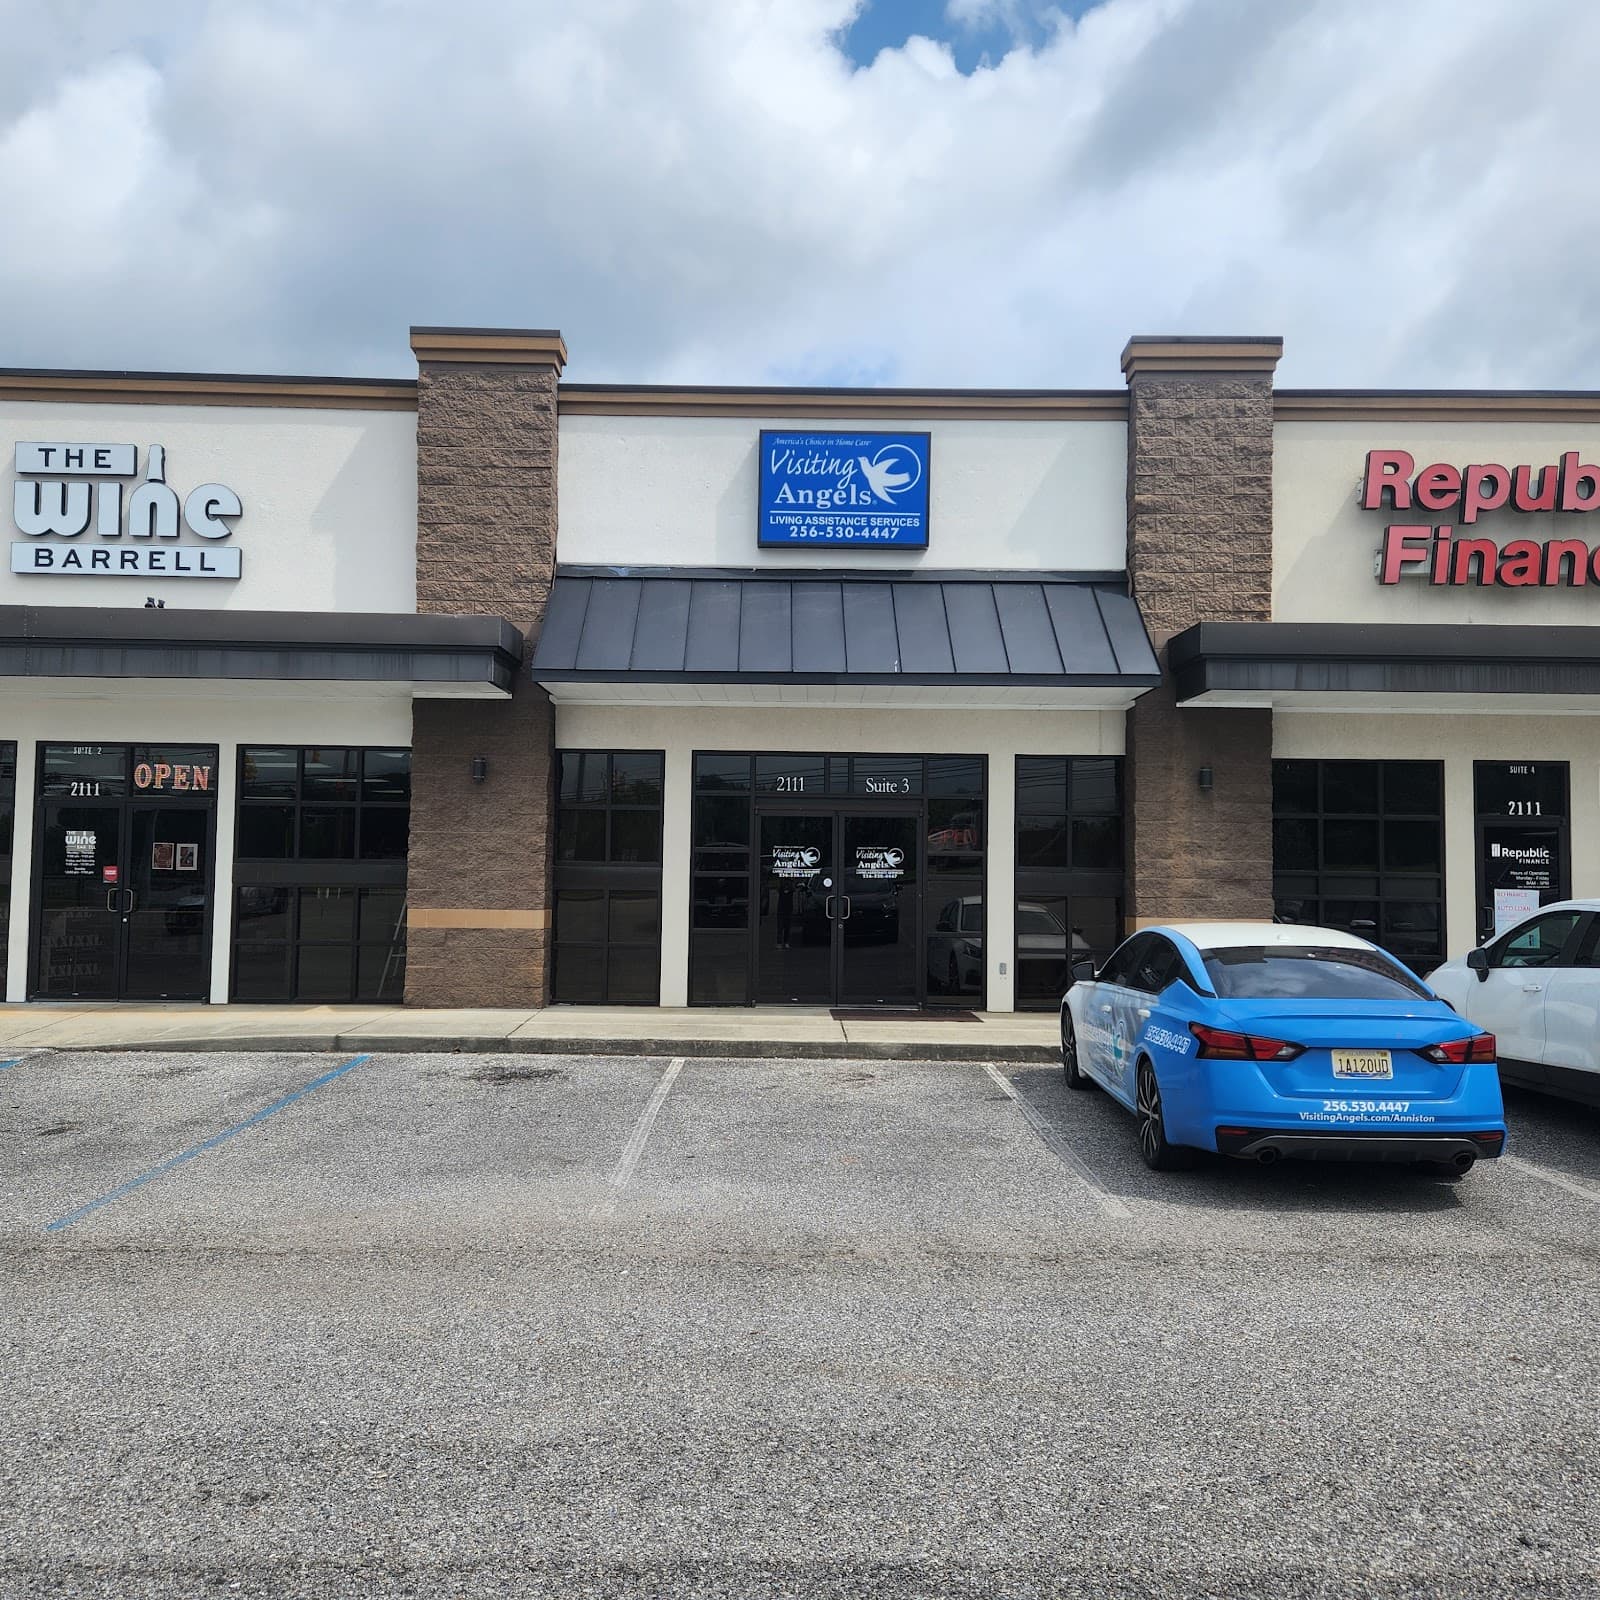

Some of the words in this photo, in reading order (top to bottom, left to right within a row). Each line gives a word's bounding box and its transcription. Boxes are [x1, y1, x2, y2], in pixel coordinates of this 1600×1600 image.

[805, 438, 826, 446] Choice
[38, 448, 111, 468] THE
[771, 449, 858, 489] Visiting
[1361, 449, 1600, 524] Repub
[774, 482, 872, 508] Angels
[770, 516, 803, 525] LIVING
[805, 517, 867, 526] ASSISTANCE
[870, 518, 920, 527] SERVICES
[789, 526, 900, 539] 256-530-4447
[35, 548, 216, 572] BARRELL
[1380, 524, 1600, 587] Finan
[97, 746, 102, 755] 2
[134, 763, 211, 791] OPEN
[1509, 766, 1528, 774] SUITE
[1531, 766, 1536, 774] 4
[70, 781, 100, 797] 2111
[776, 776, 805, 792] 2111
[865, 777, 898, 793] Suite
[901, 779, 910, 793] 3
[1508, 800, 1542, 816] 2111
[772, 849, 801, 862] Visiting
[856, 850, 884, 863] Visiting
[1501, 847, 1550, 860] Republic
[1323, 1101, 1410, 1113] 256.530.4447
[1299, 1112, 1436, 1125] VisitingAngels.com/Anniston
